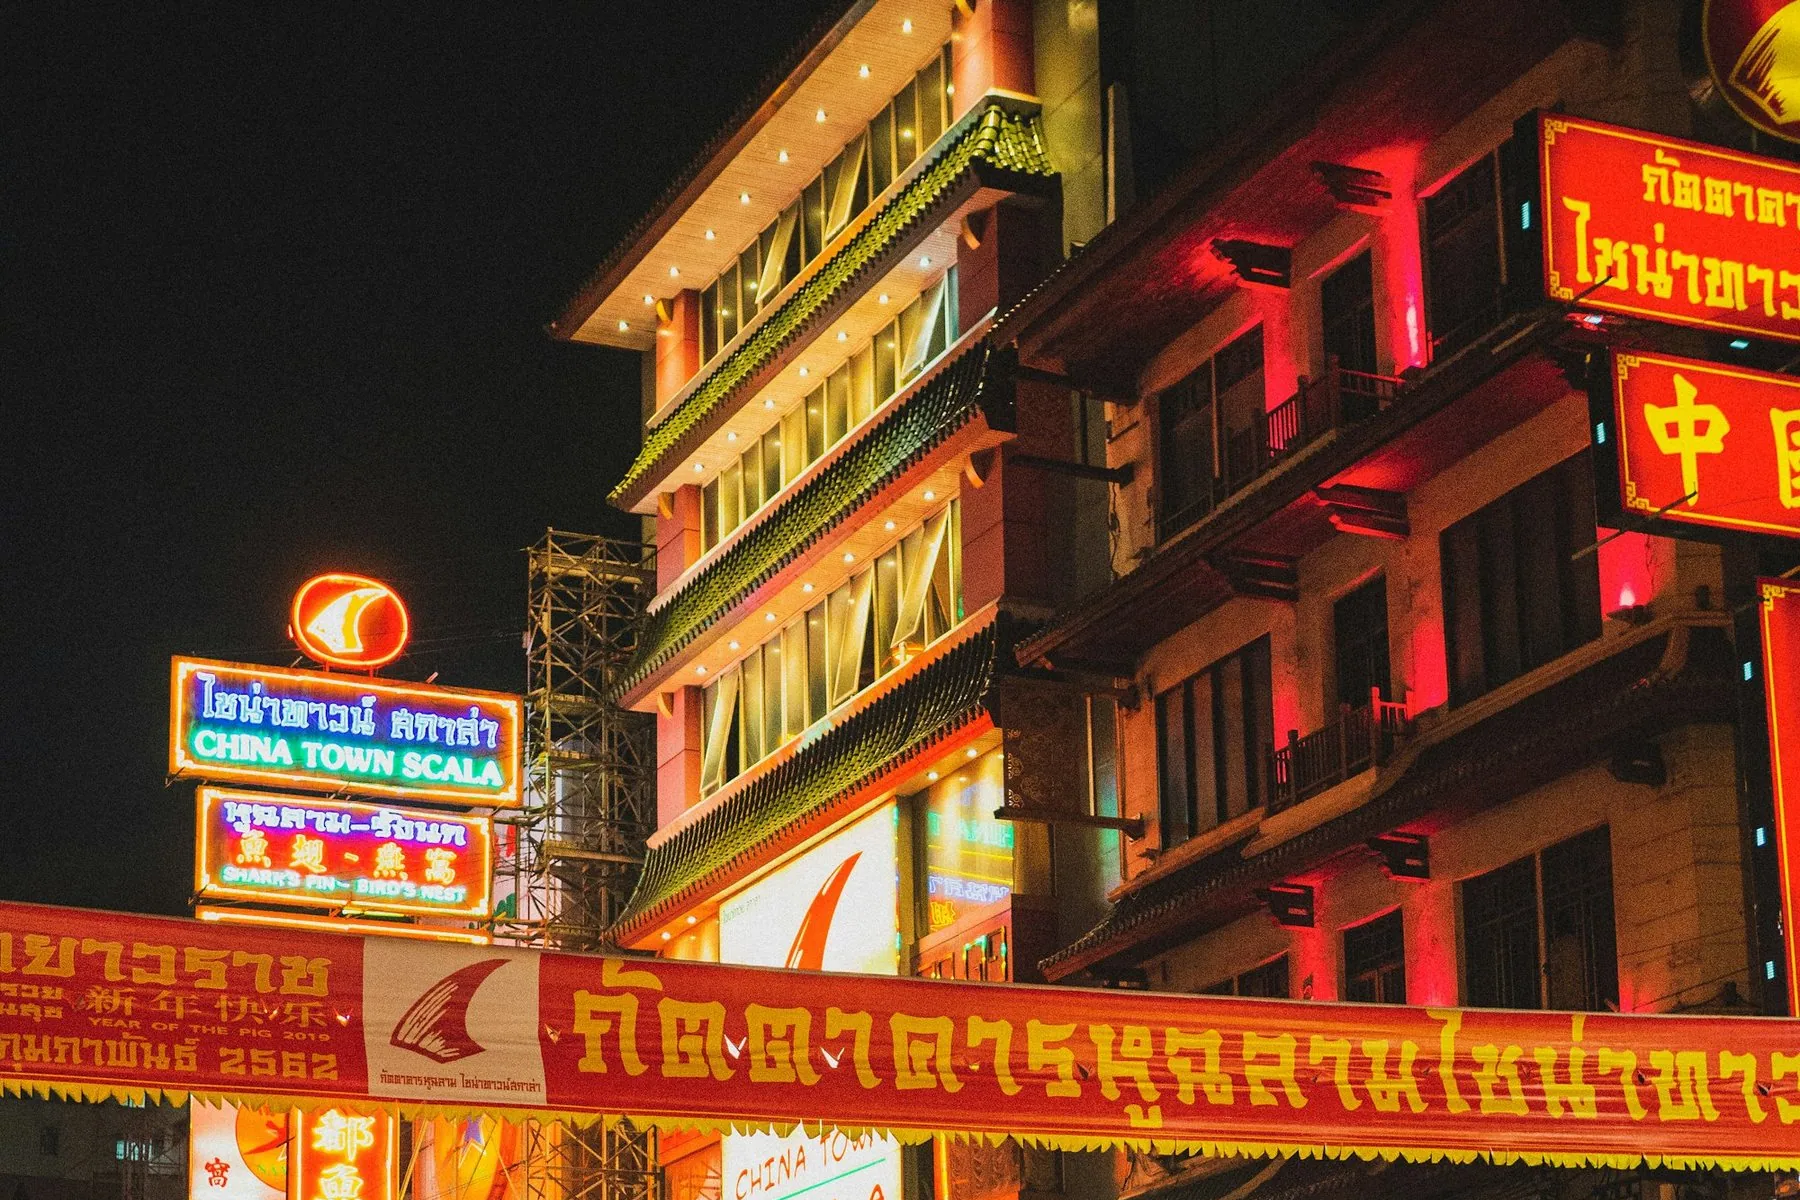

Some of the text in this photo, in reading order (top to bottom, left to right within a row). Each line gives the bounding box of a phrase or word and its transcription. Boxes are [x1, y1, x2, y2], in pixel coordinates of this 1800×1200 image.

[195, 671, 499, 749] ไชน่าทาวน์ สกาล่า
[194, 730, 504, 787] CHINA TOWN SCALA
[419, 884, 467, 903] NEST
[89, 1016, 331, 1043] YEAR OF THE PIG 2019
[219, 1047, 338, 1081] 2562
[820, 1131, 884, 1168] TOW
